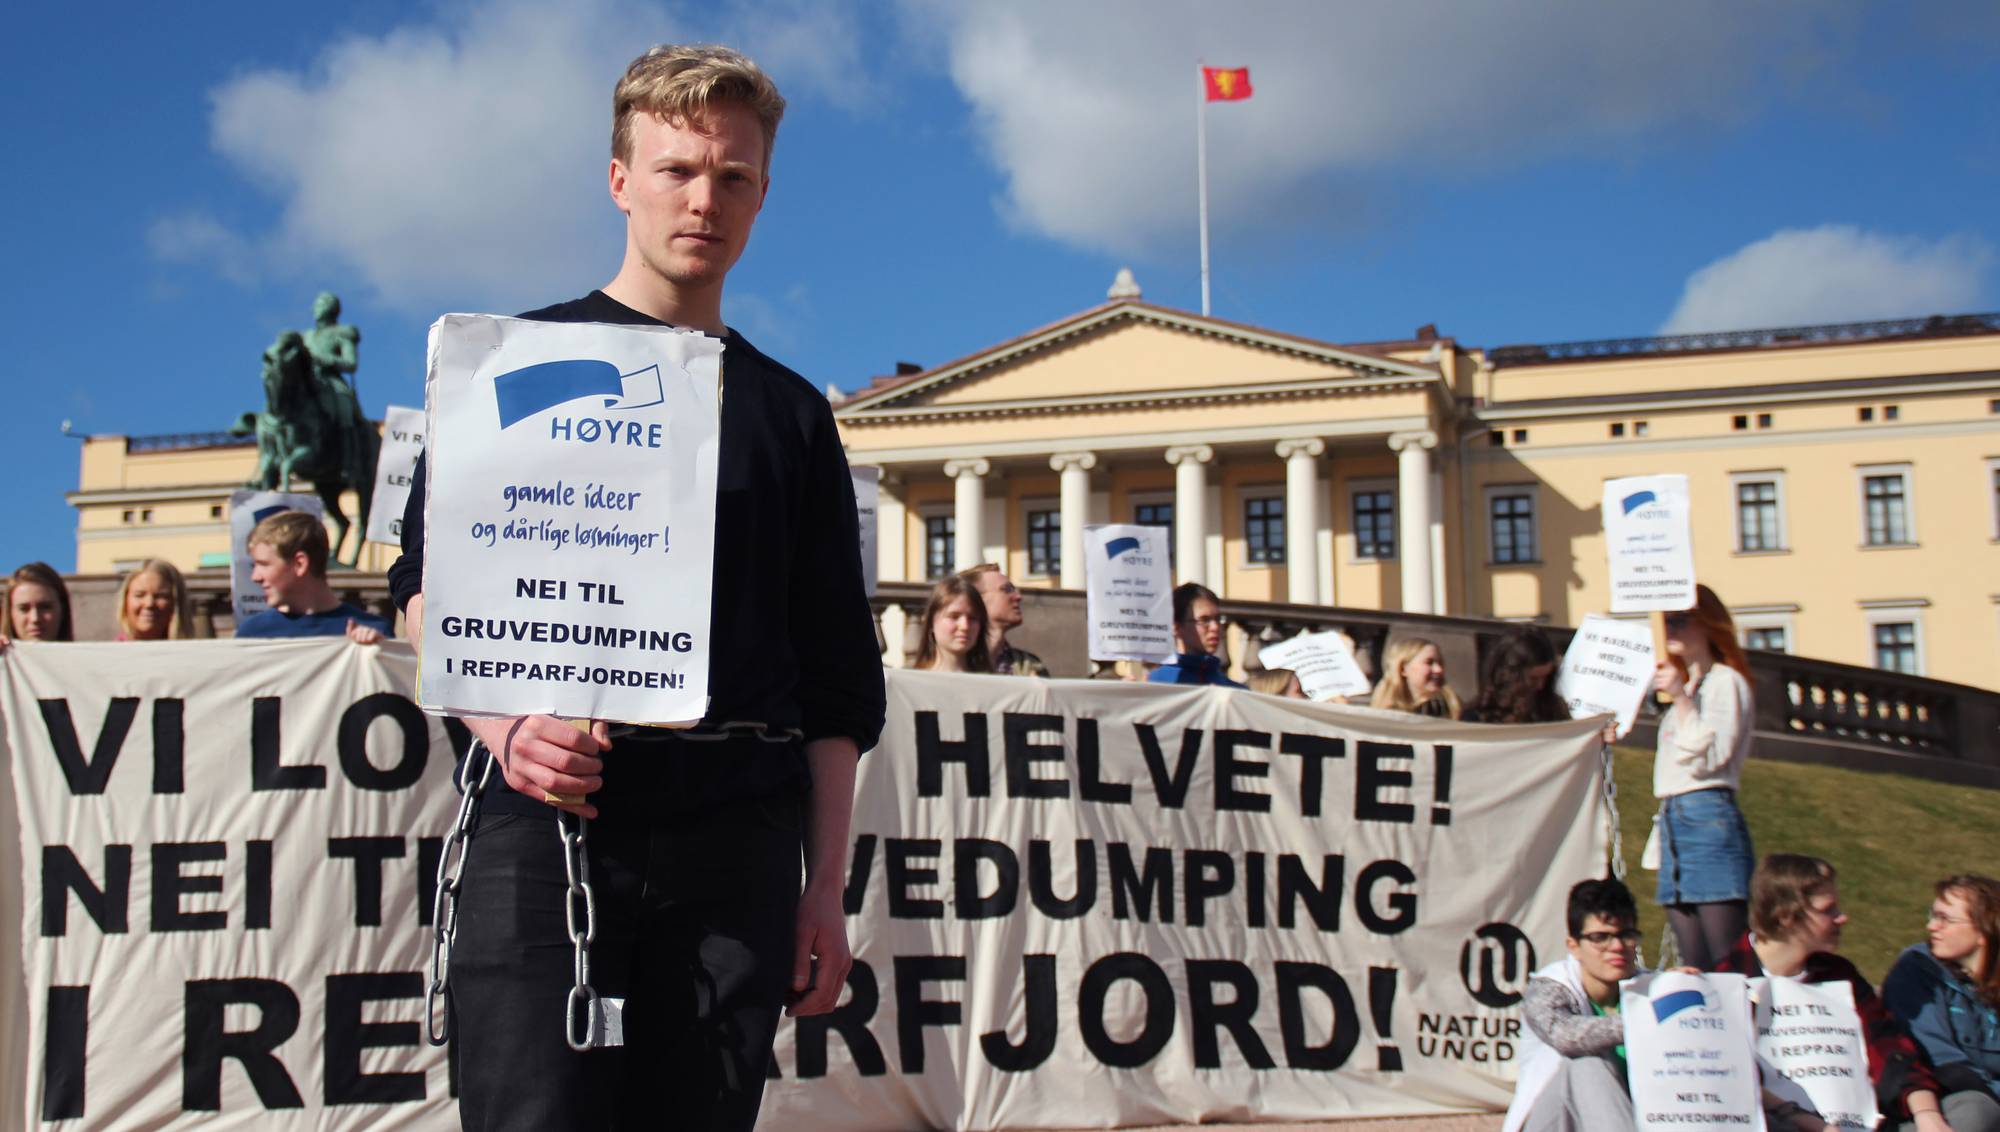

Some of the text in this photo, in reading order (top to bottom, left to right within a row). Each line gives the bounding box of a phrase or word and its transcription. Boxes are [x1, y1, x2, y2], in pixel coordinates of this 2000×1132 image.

[551, 417, 662, 448] HØYRE
[503, 480, 640, 512] gamle ideer
[471, 522, 496, 547] og
[503, 517, 570, 550] dårlige
[516, 578, 625, 605] NEI TIL
[441, 617, 692, 652] GRUVEDUMPING
[446, 658, 684, 689] I REPPARFJORDEN!
[37, 692, 1453, 826] VI LO HELVETE!
[41, 840, 273, 937] NEI
[1418, 1012, 1521, 1038] NATUR
[42, 985, 90, 1121] I
[182, 971, 460, 1112] RE
[1417, 1036, 1514, 1062] UNGD
